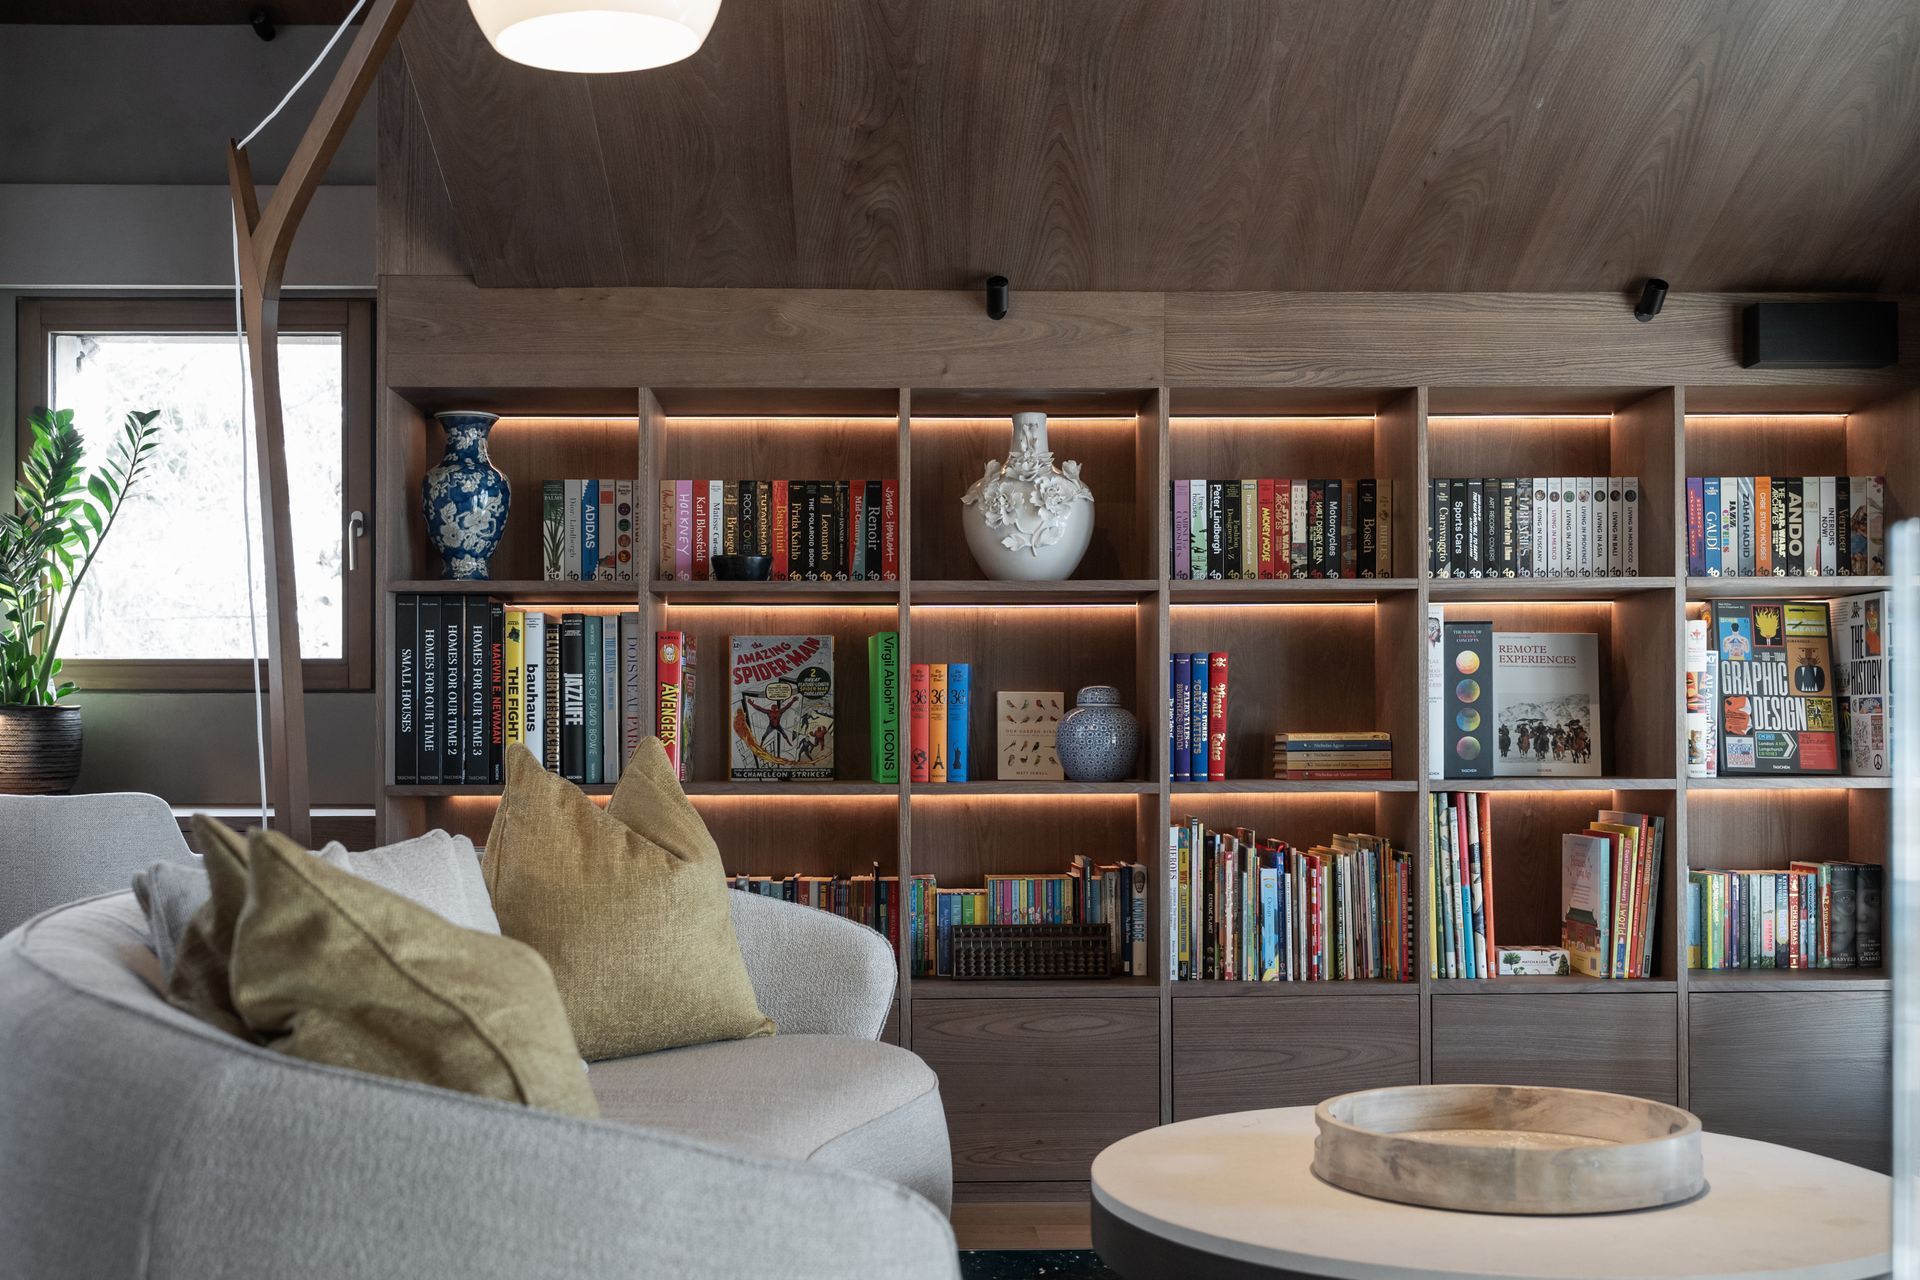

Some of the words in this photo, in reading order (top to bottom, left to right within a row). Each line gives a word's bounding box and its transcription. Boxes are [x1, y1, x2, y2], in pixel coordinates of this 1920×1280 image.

[696, 497, 706, 516] Karl
[743, 493, 752, 521] ROCK
[1213, 484, 1222, 508] Peter
[585, 504, 596, 549] ADIDAS
[677, 494, 690, 556] HOCKNEY
[774, 505, 787, 553] Basquiat
[791, 503, 801, 529] Frida
[854, 496, 862, 545] Mid-Century
[868, 506, 880, 551] Renoir
[1212, 510, 1222, 554] Lindbergh
[1261, 507, 1271, 536] MICKEY
[1327, 501, 1338, 556] Motorcycles
[1453, 501, 1463, 532] Sports
[1504, 506, 1513, 529] Godfather
[1706, 511, 1720, 551] GAUDÍ
[1722, 509, 1730, 553] COVERS
[1789, 491, 1802, 557] ANDO
[1839, 508, 1849, 553] Vermeer
[696, 519, 706, 562] Blossfeldt
[725, 517, 737, 556] Bruegel
[791, 531, 801, 560] Kahlo
[821, 514, 831, 560] Leonardo
[1261, 537, 1271, 562] MOUSE
[1363, 518, 1375, 553] Bosch
[1379, 525, 1388, 560] BIBLES
[1437, 507, 1448, 562] Caravaggio
[1455, 533, 1463, 554] Cars
[1503, 529, 1513, 545] Family
[1597, 534, 1602, 542] IN
[1504, 546, 1513, 561] Album
[424, 629, 434, 669] HOMES
[447, 624, 458, 664] HOMES
[472, 625, 483, 665] HOMES
[546, 632, 560, 667] ELVIS
[737, 642, 792, 665] AMAZING
[751, 641, 763, 649] the
[881, 636, 895, 666] Virgil
[1498, 645, 1547, 654] REMOTE
[1850, 625, 1865, 659] THE
[401, 648, 412, 687] SMALL
[492, 643, 501, 683] MARVIN
[588, 652, 597, 666] THE
[626, 637, 639, 713] DOISNEAU
[733, 636, 821, 686] SPIDER-MAN
[810, 669, 817, 678] 2
[1498, 655, 1577, 665] EXPERIENCES
[424, 671, 434, 694] FOR
[447, 667, 458, 689] FOR
[472, 667, 483, 690] FOR
[492, 685, 501, 695] E.
[508, 666, 519, 694] THE
[546, 672, 560, 707] BIRTH
[588, 669, 597, 685] RISE
[1721, 660, 1788, 696] GRAPHIC
[1851, 659, 1882, 696] HISTORY
[424, 695, 434, 720] OUR
[447, 691, 458, 716] OUR
[472, 692, 483, 717] OUR
[526, 663, 538, 732] bauhaus
[563, 672, 583, 726] JAZZLIFE
[588, 687, 597, 700] OF
[911, 689, 927, 704] 36
[1176, 684, 1184, 722] BROTHERS
[1193, 684, 1202, 712] GREAT
[1211, 683, 1226, 718] Pirate
[401, 688, 412, 733] HOUSES
[492, 697, 501, 744] NEWMAN
[508, 697, 519, 740] FIGHT
[546, 711, 560, 742] ROCK
[588, 703, 597, 726] DAVID
[661, 683, 678, 747] AVENGERS
[1753, 696, 1807, 731] DESIGN
[424, 722, 434, 751] TIME
[447, 717, 458, 747] TIME
[472, 718, 483, 747] TIME
[588, 728, 597, 755] BOWIE
[626, 716, 639, 759] PARIS
[1176, 725, 1184, 751] GRIMM
[1193, 715, 1202, 754] ARTISTS
[1211, 732, 1226, 761] Tales
[883, 729, 895, 771] ICONS
[1623, 849, 1631, 874] Questions
[1644, 859, 1652, 885] ODDITIES
[1132, 897, 1145, 943] KNOWLEDGE
